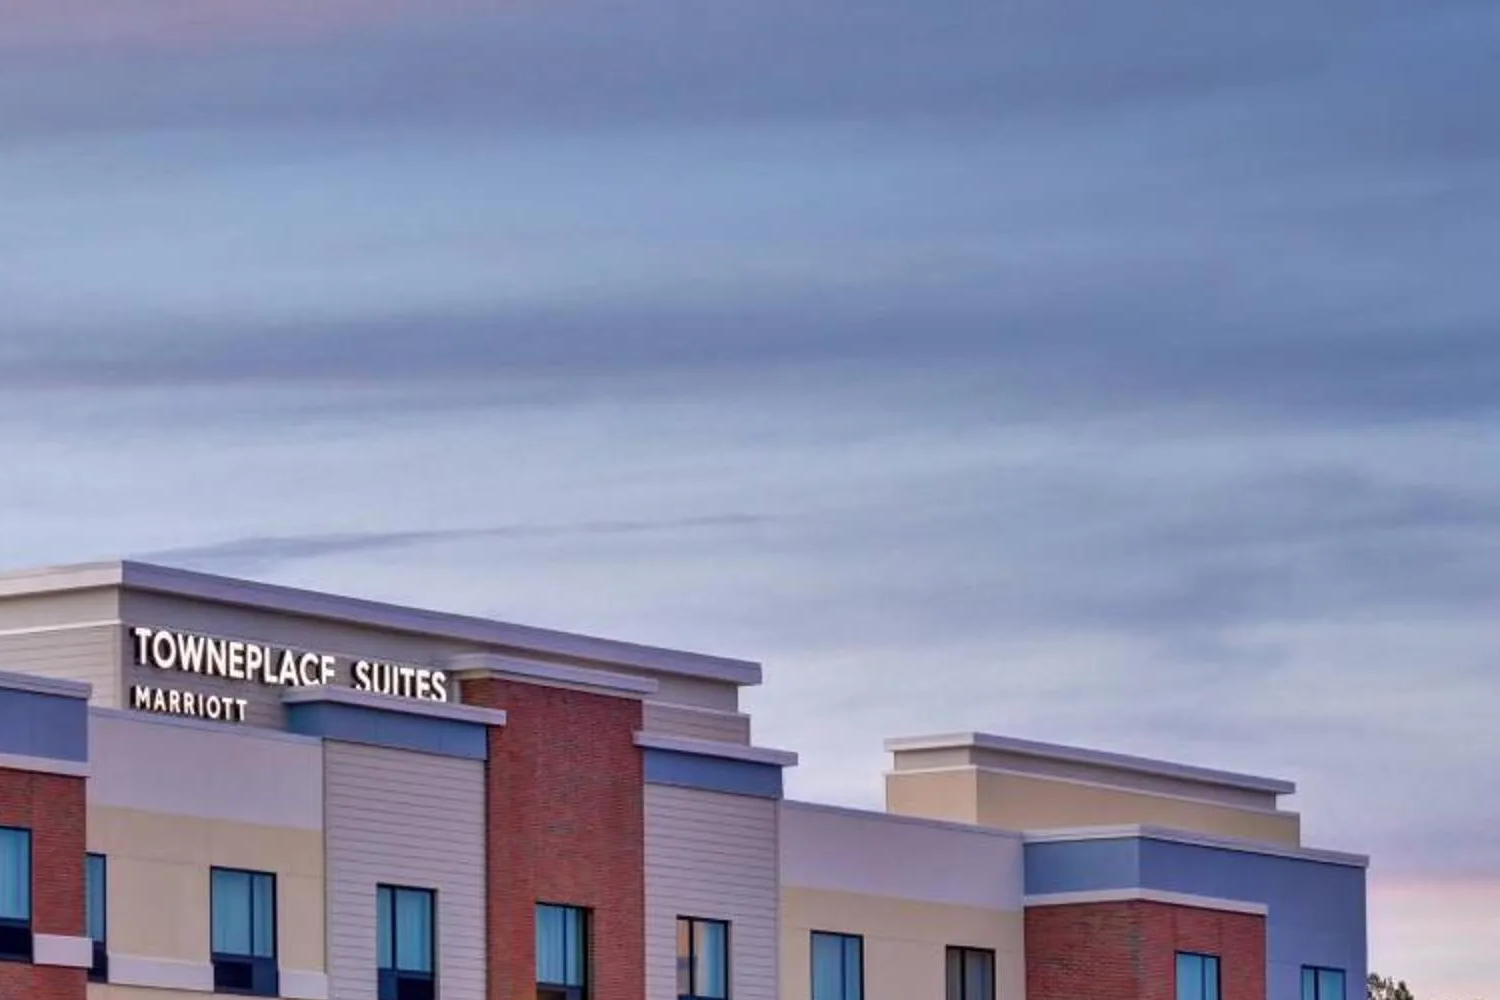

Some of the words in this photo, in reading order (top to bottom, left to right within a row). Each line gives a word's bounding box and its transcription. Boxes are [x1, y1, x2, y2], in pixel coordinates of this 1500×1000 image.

[135, 627, 336, 686] TOWNEPLACE
[356, 660, 447, 703] SUITES
[135, 684, 248, 721] MARRIOTT
